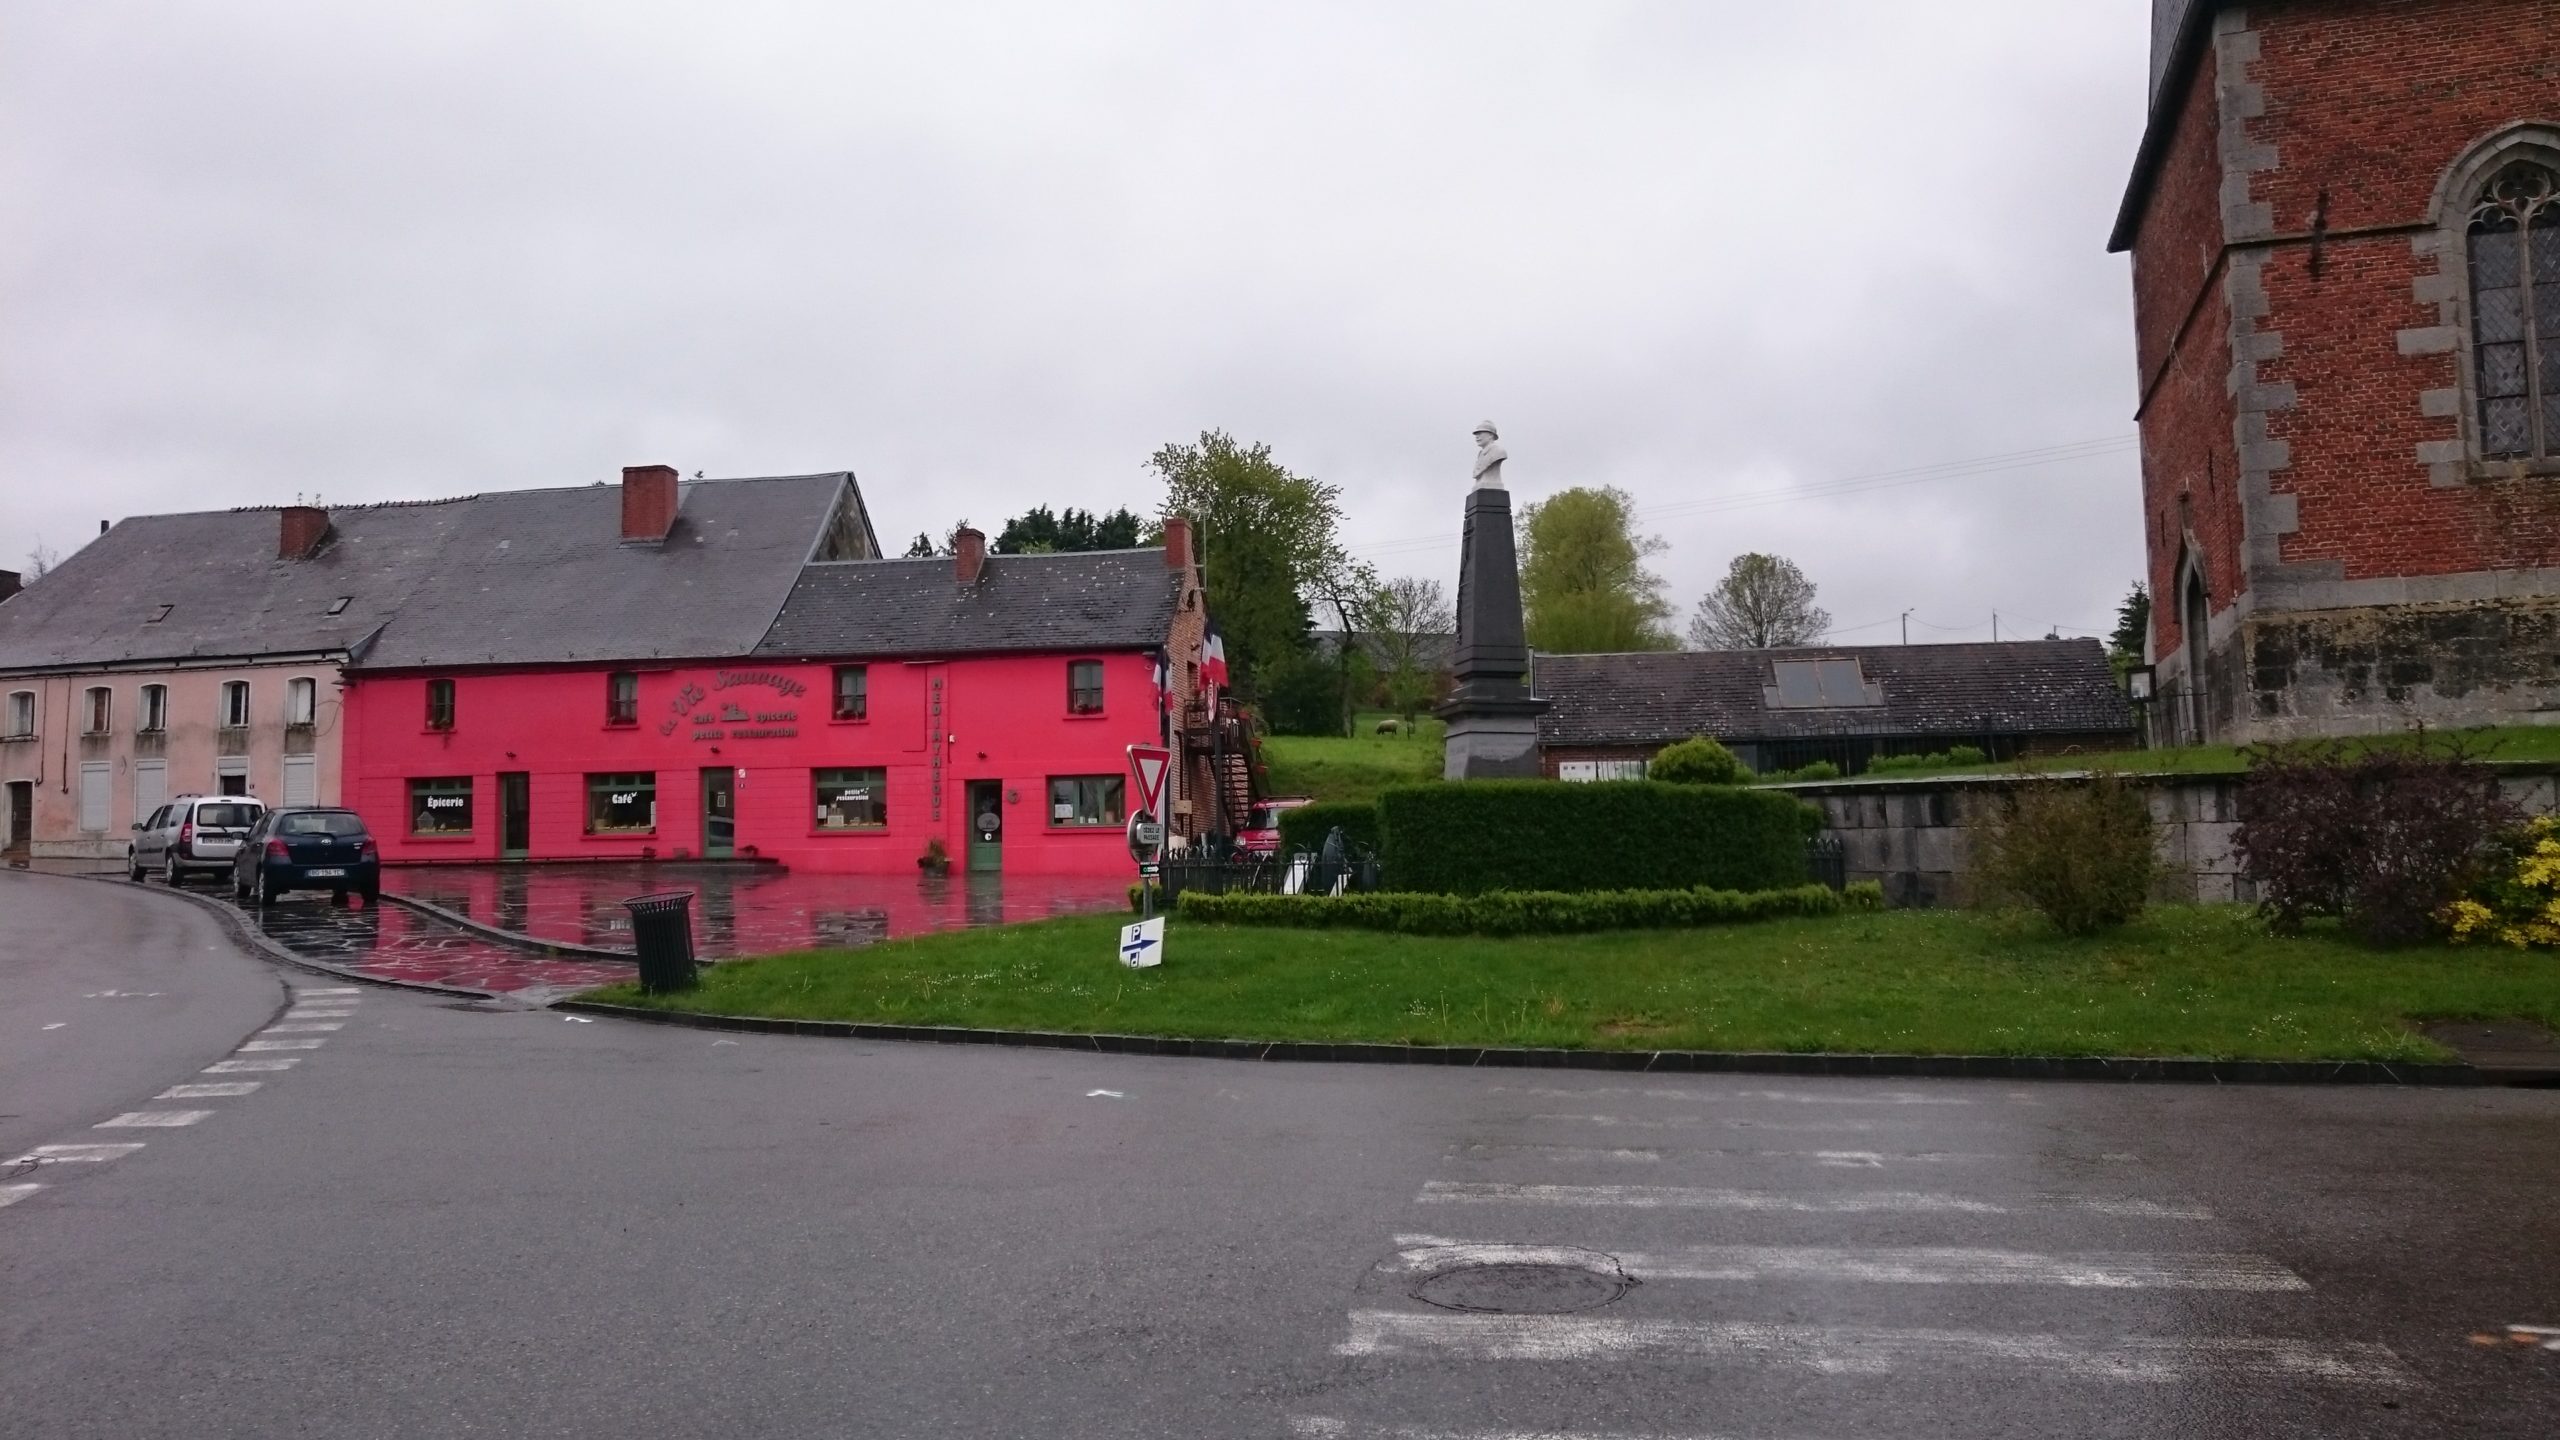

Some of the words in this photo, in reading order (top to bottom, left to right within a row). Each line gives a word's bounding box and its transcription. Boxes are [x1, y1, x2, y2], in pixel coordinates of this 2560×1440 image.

[712, 670, 807, 698] Sauvage
[731, 727, 798, 738] restauration
[427, 795, 464, 809] Épicerie
[1132, 926, 1141, 941] P
